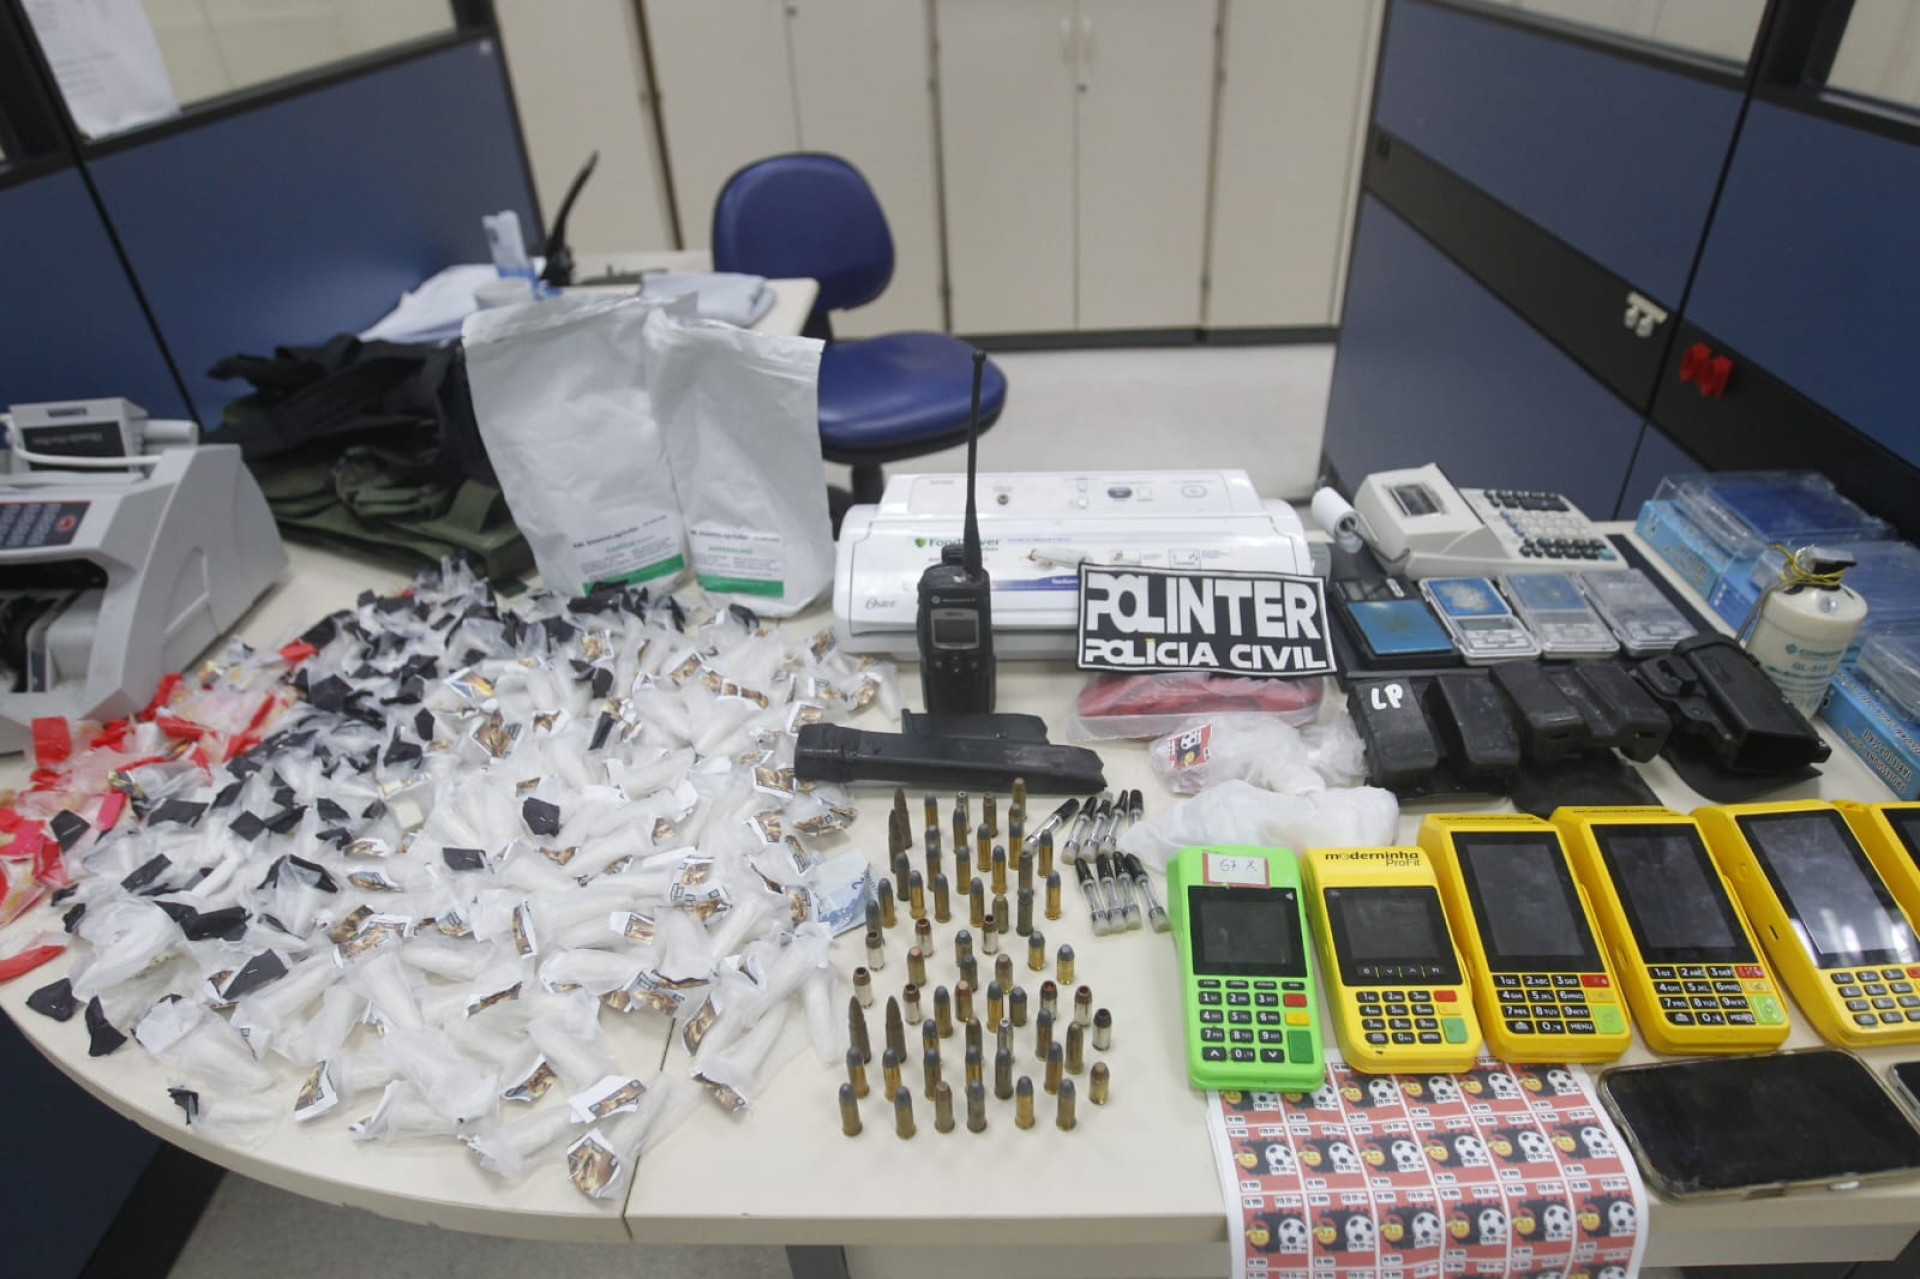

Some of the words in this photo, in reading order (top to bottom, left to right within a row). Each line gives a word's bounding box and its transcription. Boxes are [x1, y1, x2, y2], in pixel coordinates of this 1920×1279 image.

[929, 536, 1000, 547] Foodver
[1086, 572, 1322, 640] POLINTER
[1229, 643, 1328, 671] CIVIL
[1371, 683, 1403, 710] LP
[1386, 859, 1421, 867] ProFit
